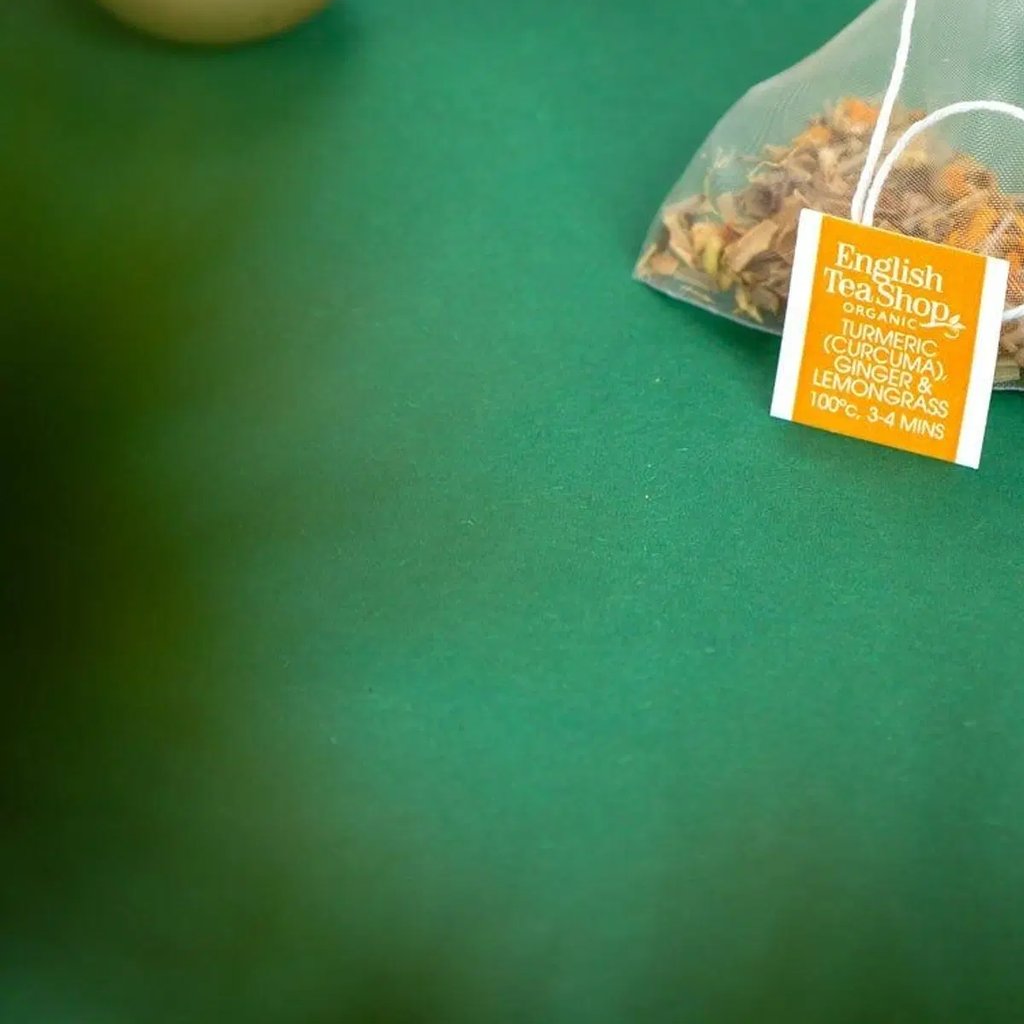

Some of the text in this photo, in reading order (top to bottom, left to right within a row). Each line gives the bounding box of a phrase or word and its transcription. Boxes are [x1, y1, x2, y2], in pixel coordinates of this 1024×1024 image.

[834, 241, 945, 294] English
[842, 301, 919, 331] ORGANIC
[823, 334, 949, 382] (CURCUMA),
[841, 318, 939, 358] TURMERIC
[812, 367, 950, 419] LEMONGRASS
[833, 354, 934, 396] GINGER &
[866, 406, 897, 429] 3-4
[899, 414, 947, 440] MINS
